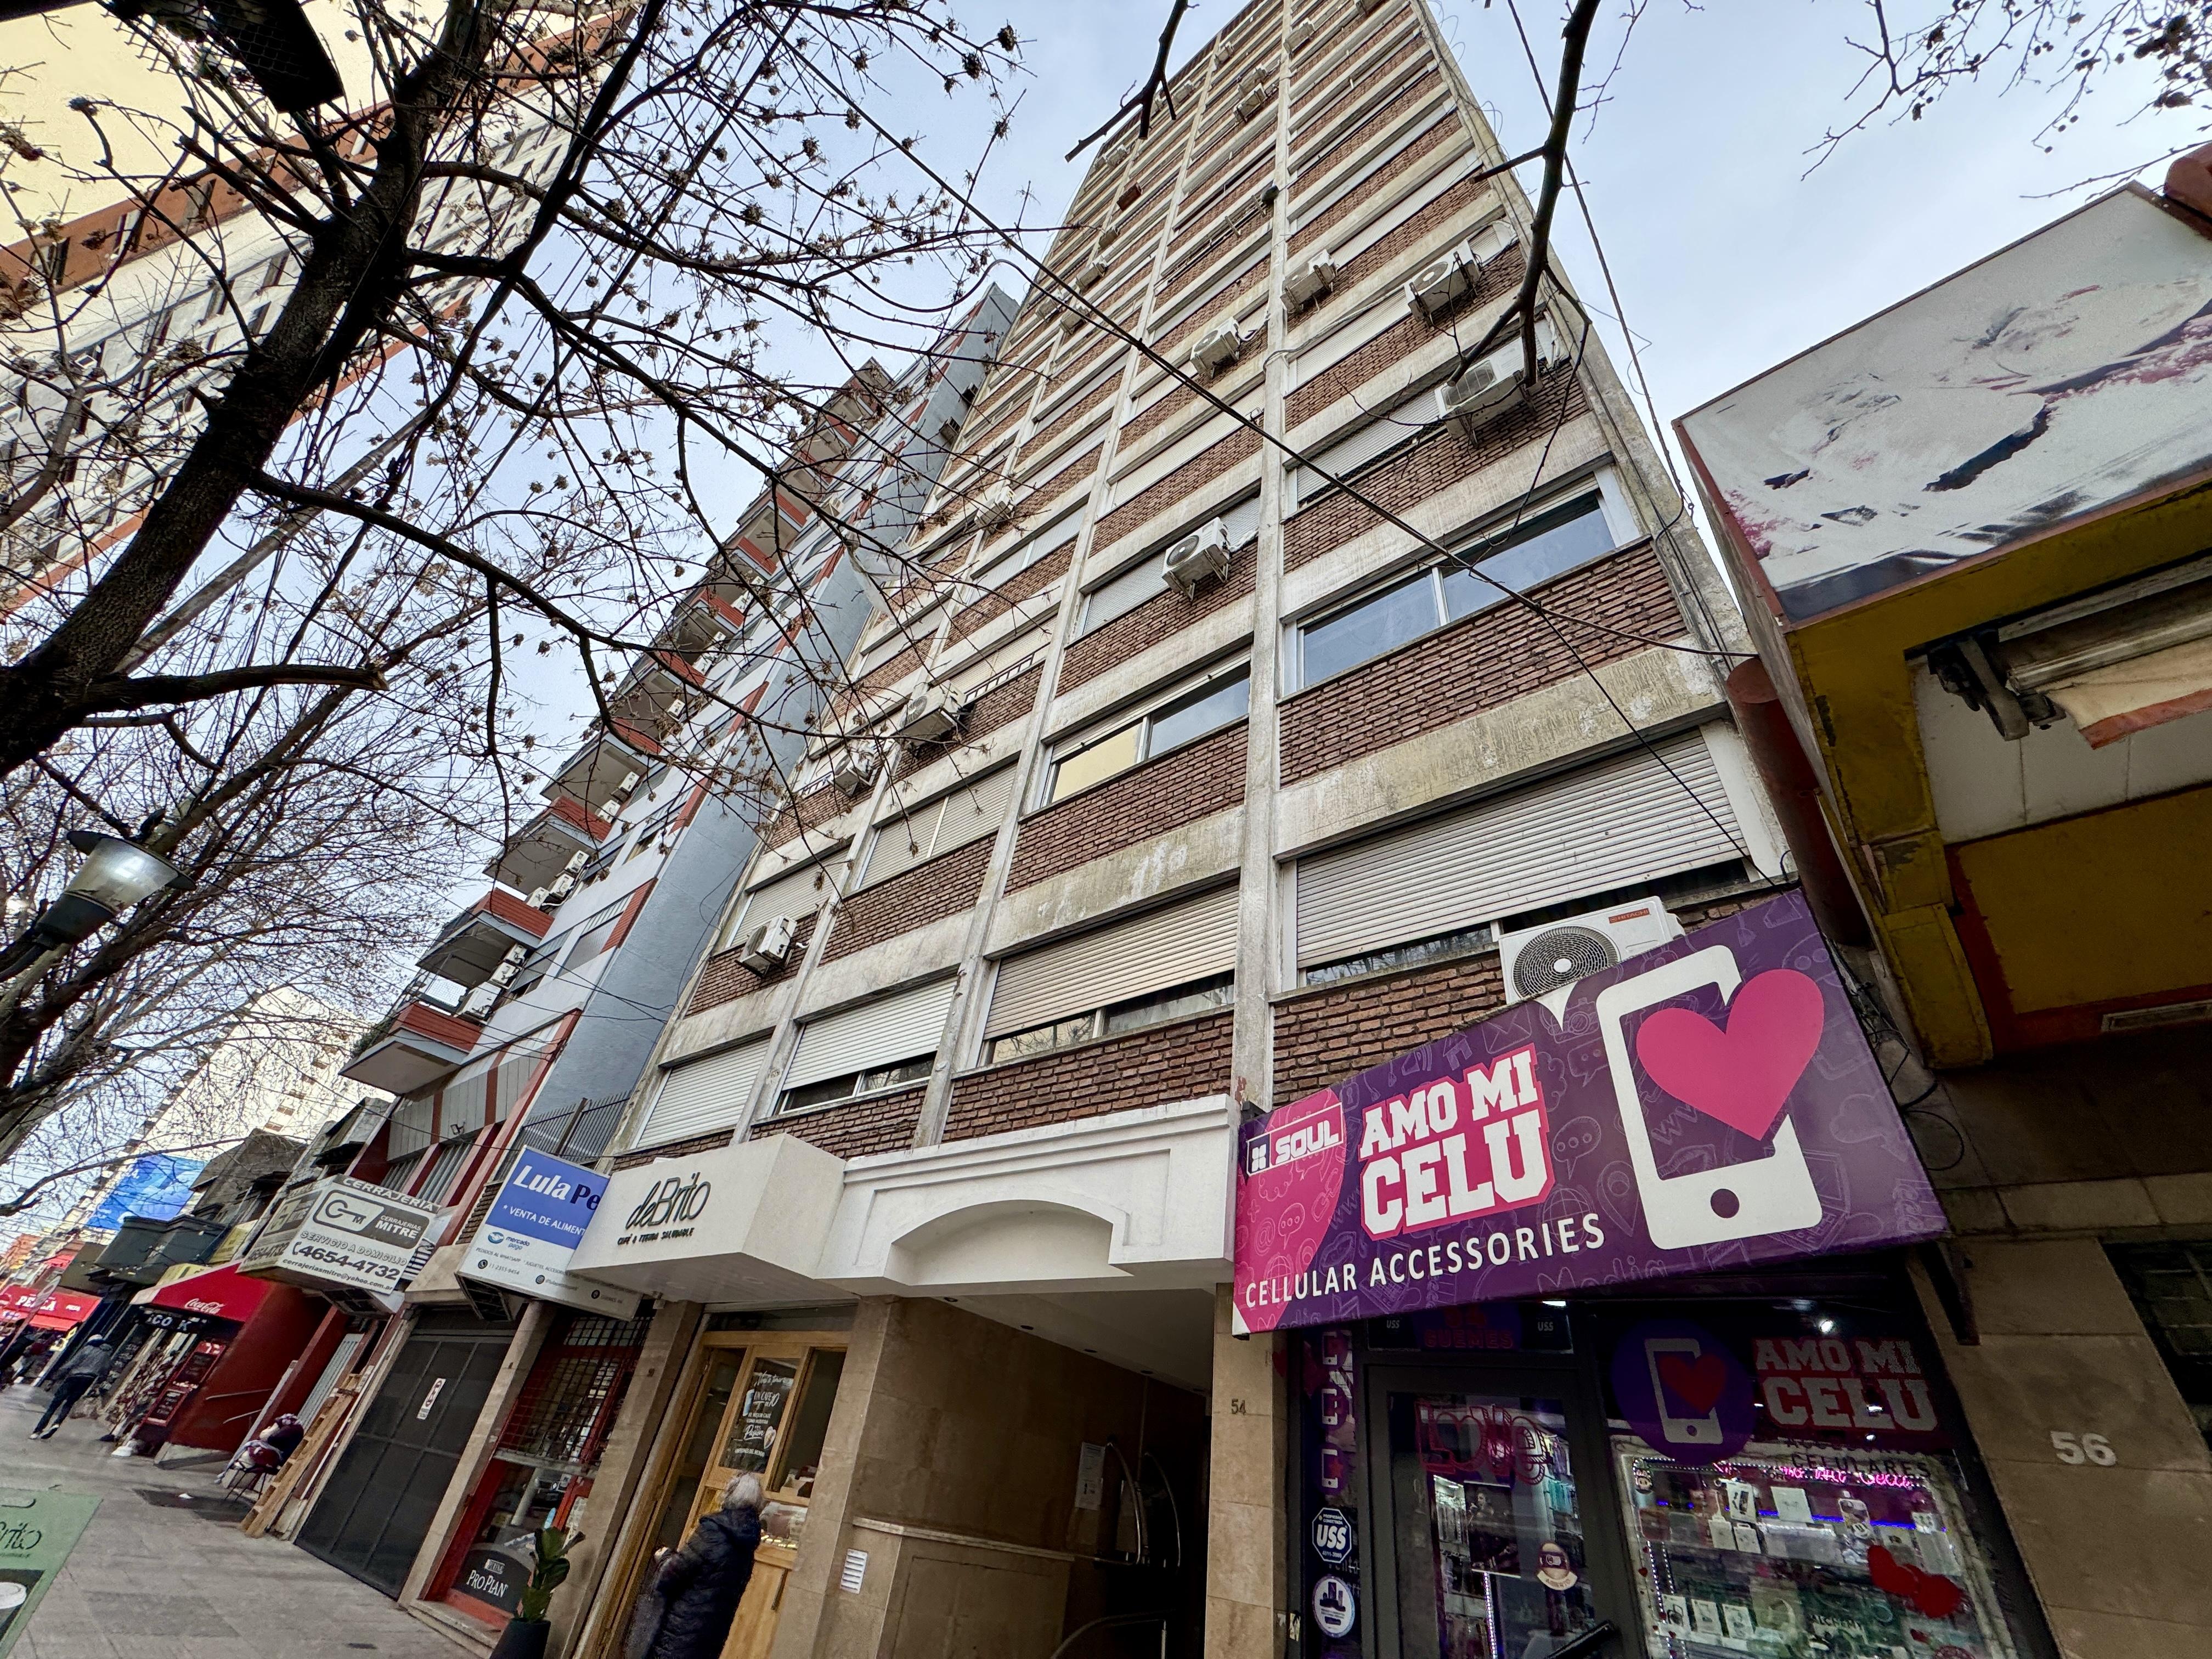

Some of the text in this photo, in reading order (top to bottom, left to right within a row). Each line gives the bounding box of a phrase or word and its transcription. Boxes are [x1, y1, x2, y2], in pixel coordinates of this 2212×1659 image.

[1618, 909, 1648, 920] HITACHI
[1359, 1051, 1538, 1159] AMO MI
[1276, 1120, 1339, 1164] SOUL
[1362, 1110, 1549, 1235] CELU
[342, 1178, 435, 1211] CERRAJERIA
[513, 1165, 601, 1210] Lula Pe
[375, 1220, 419, 1239] MITRE
[380, 1215, 421, 1231] CERRAJERIAS
[509, 1206, 537, 1221] VENTA
[538, 1215, 551, 1226] DE
[300, 1231, 407, 1266] SERVICIO A DOMICILIO
[476, 1247, 494, 1256] PEDIDOS
[506, 1235, 531, 1246] mercado
[298, 1245, 400, 1280] 4654-4732
[1245, 1212, 1605, 1308] CELLULAR ACCESSORIES
[283, 1259, 393, 1290] cerrajeriasmitre@yahoo.com.ar
[1386, 1319, 1400, 1330] USS
[1537, 1321, 1554, 1332] USS
[1425, 1329, 1514, 1350] GUEMES
[1756, 1340, 1921, 1374] AMO MI
[1231, 1398, 1246, 1414] 54
[1762, 1376, 1939, 1431] CELU
[2050, 1430, 2117, 1466] 56
[1792, 1453, 1932, 1478] CELULARES
[1317, 1524, 1347, 1550] USS
[466, 1570, 509, 1598] PRO PLAN
